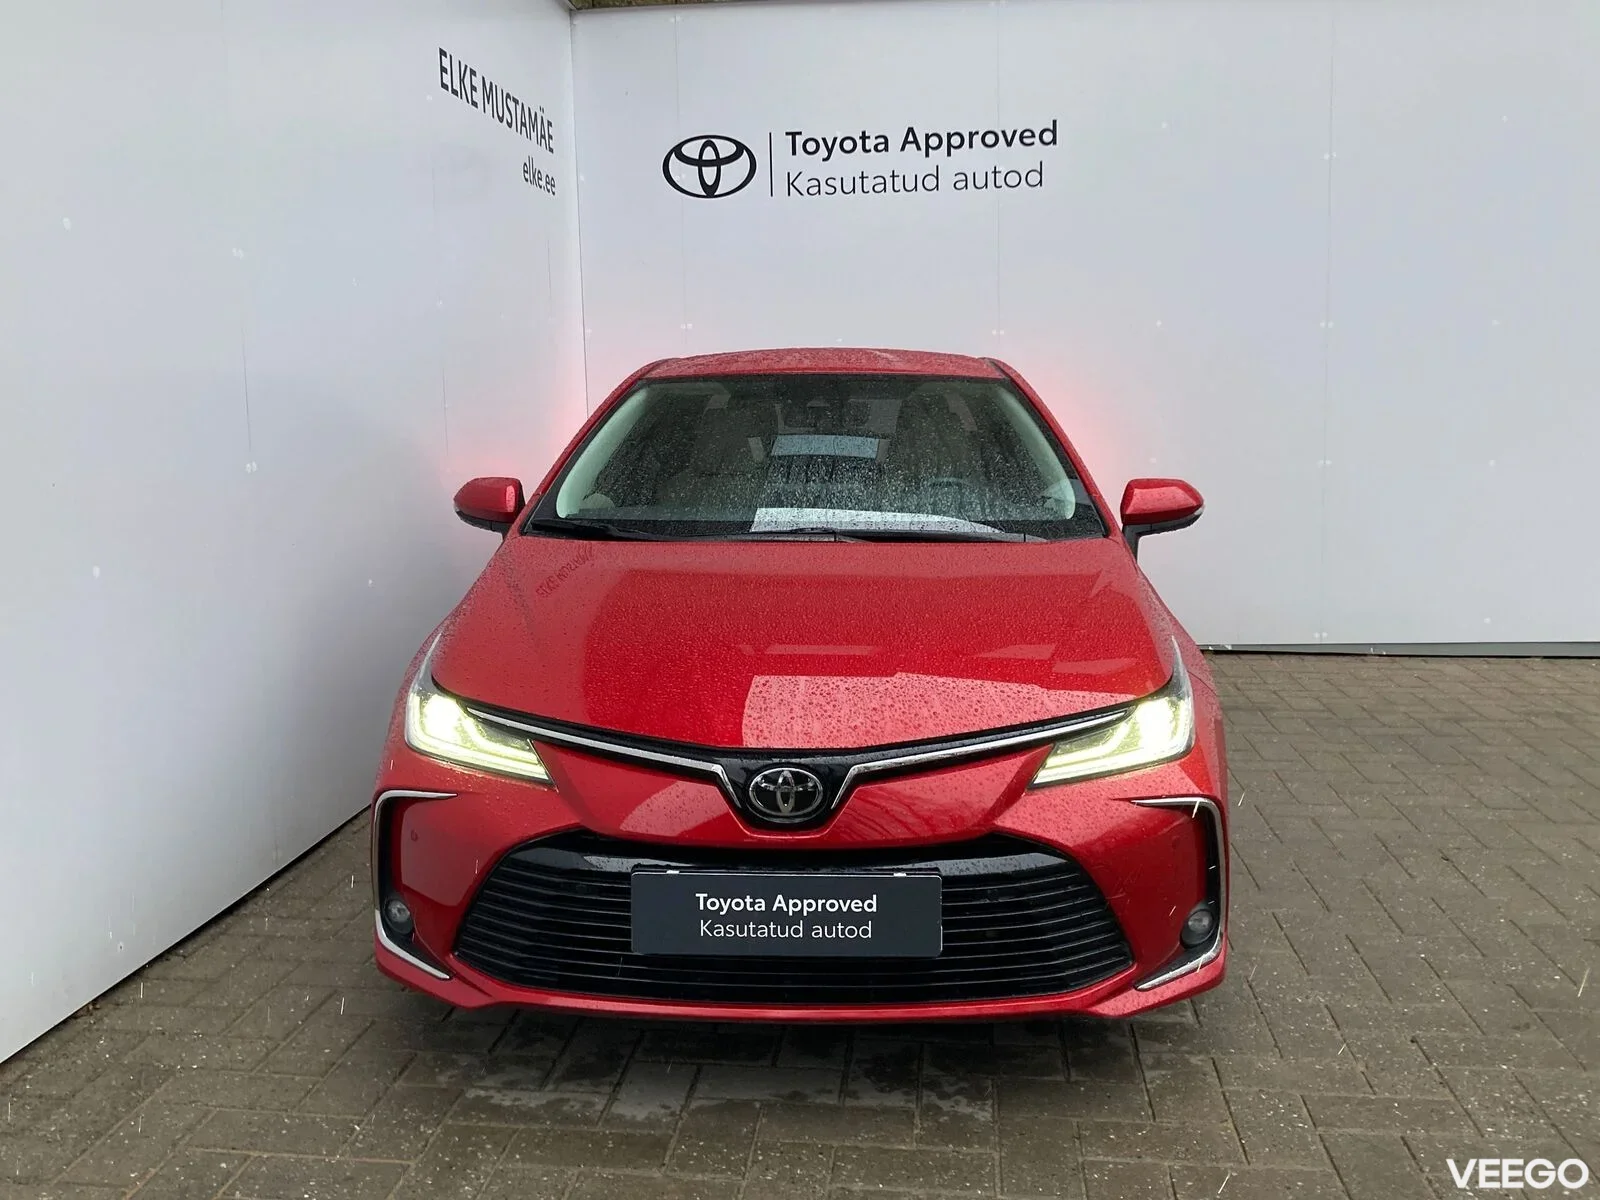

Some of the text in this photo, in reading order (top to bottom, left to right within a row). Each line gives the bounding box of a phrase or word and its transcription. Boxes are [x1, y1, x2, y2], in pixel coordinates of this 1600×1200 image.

[438, 47, 554, 154] ELKE MUSTAMÄE
[785, 119, 1058, 162] Toyota Approved
[522, 155, 556, 196] elke.ee
[786, 160, 1043, 197] Kasutatud autod
[695, 893, 877, 916] Toyota Approved
[700, 919, 872, 939] Kasutatud autod
